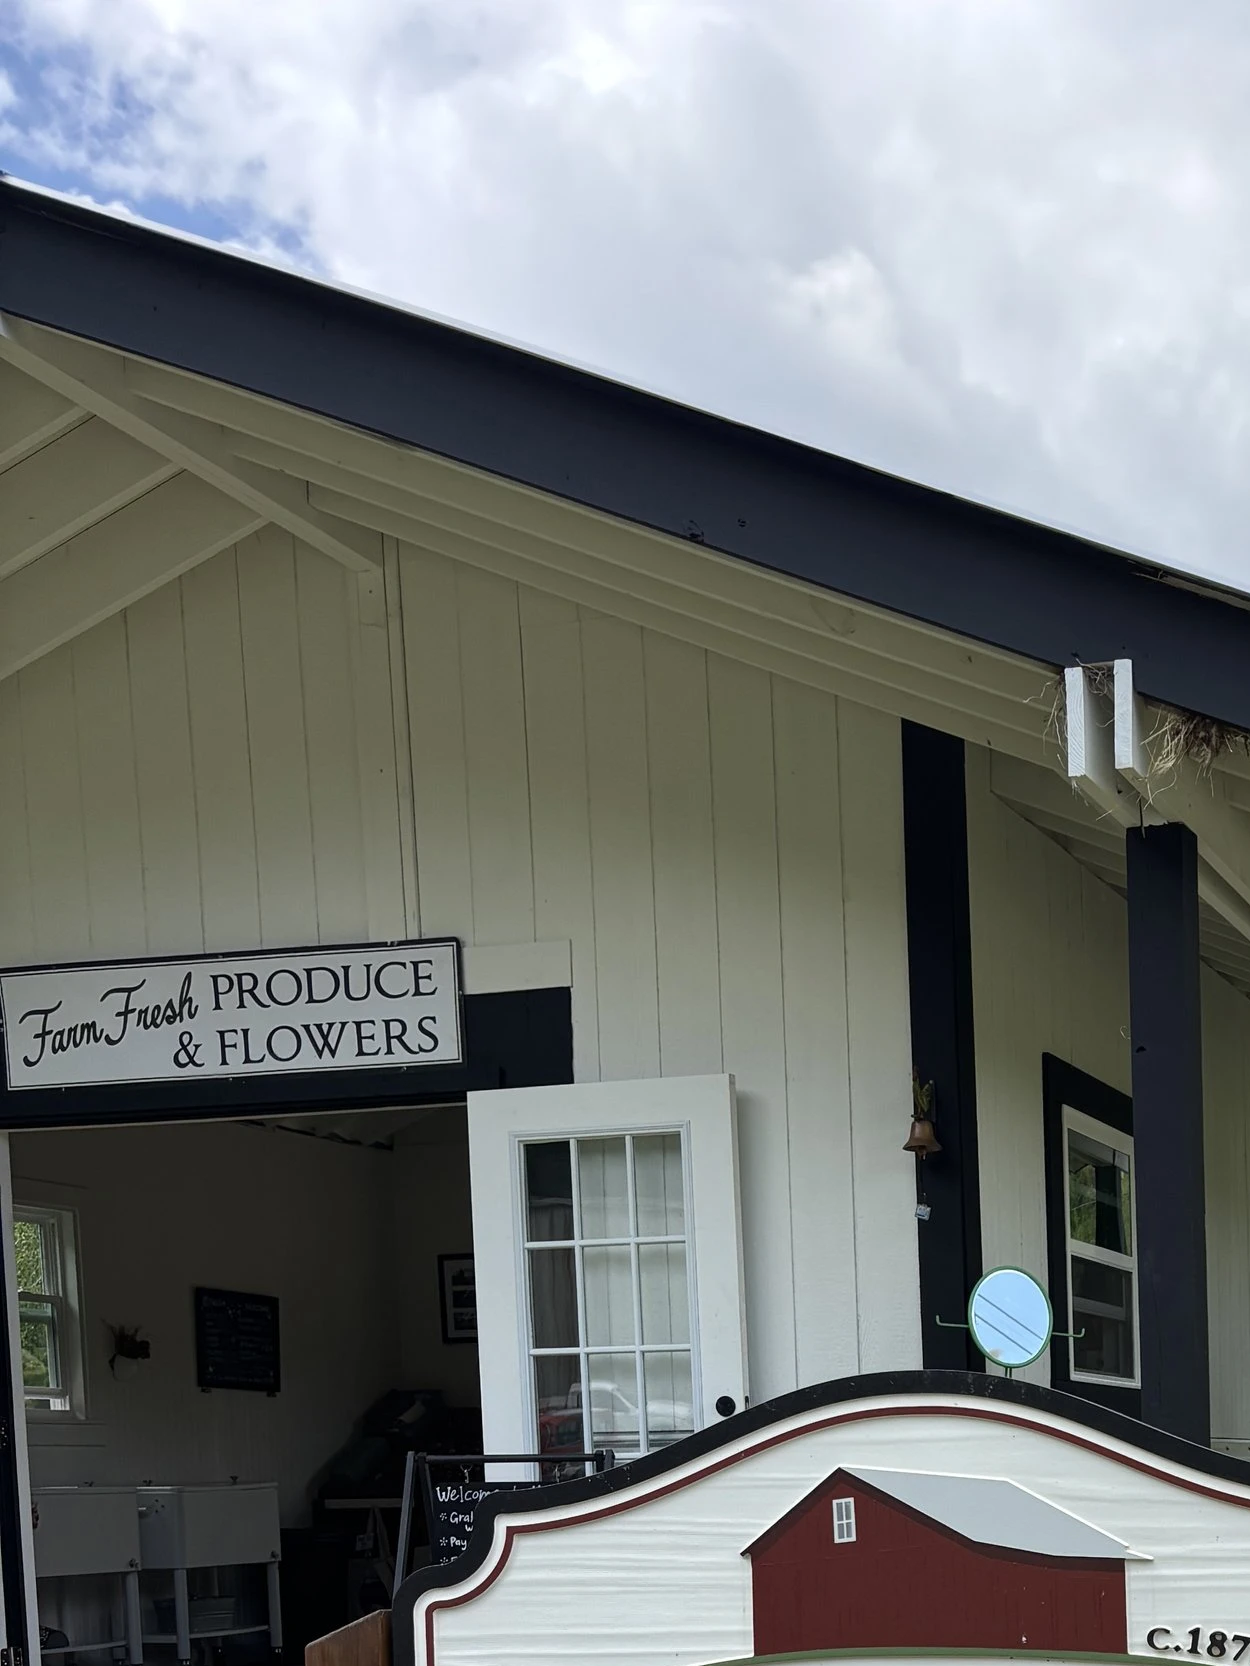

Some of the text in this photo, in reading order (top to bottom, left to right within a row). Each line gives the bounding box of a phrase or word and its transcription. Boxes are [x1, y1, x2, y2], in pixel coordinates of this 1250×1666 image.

[18, 959, 438, 1068] Farm Fresh PRODUCE
[172, 1015, 440, 1069] & FLOWERS
[436, 1485, 500, 1502] Welcom
[450, 1536, 467, 1551] Pay
